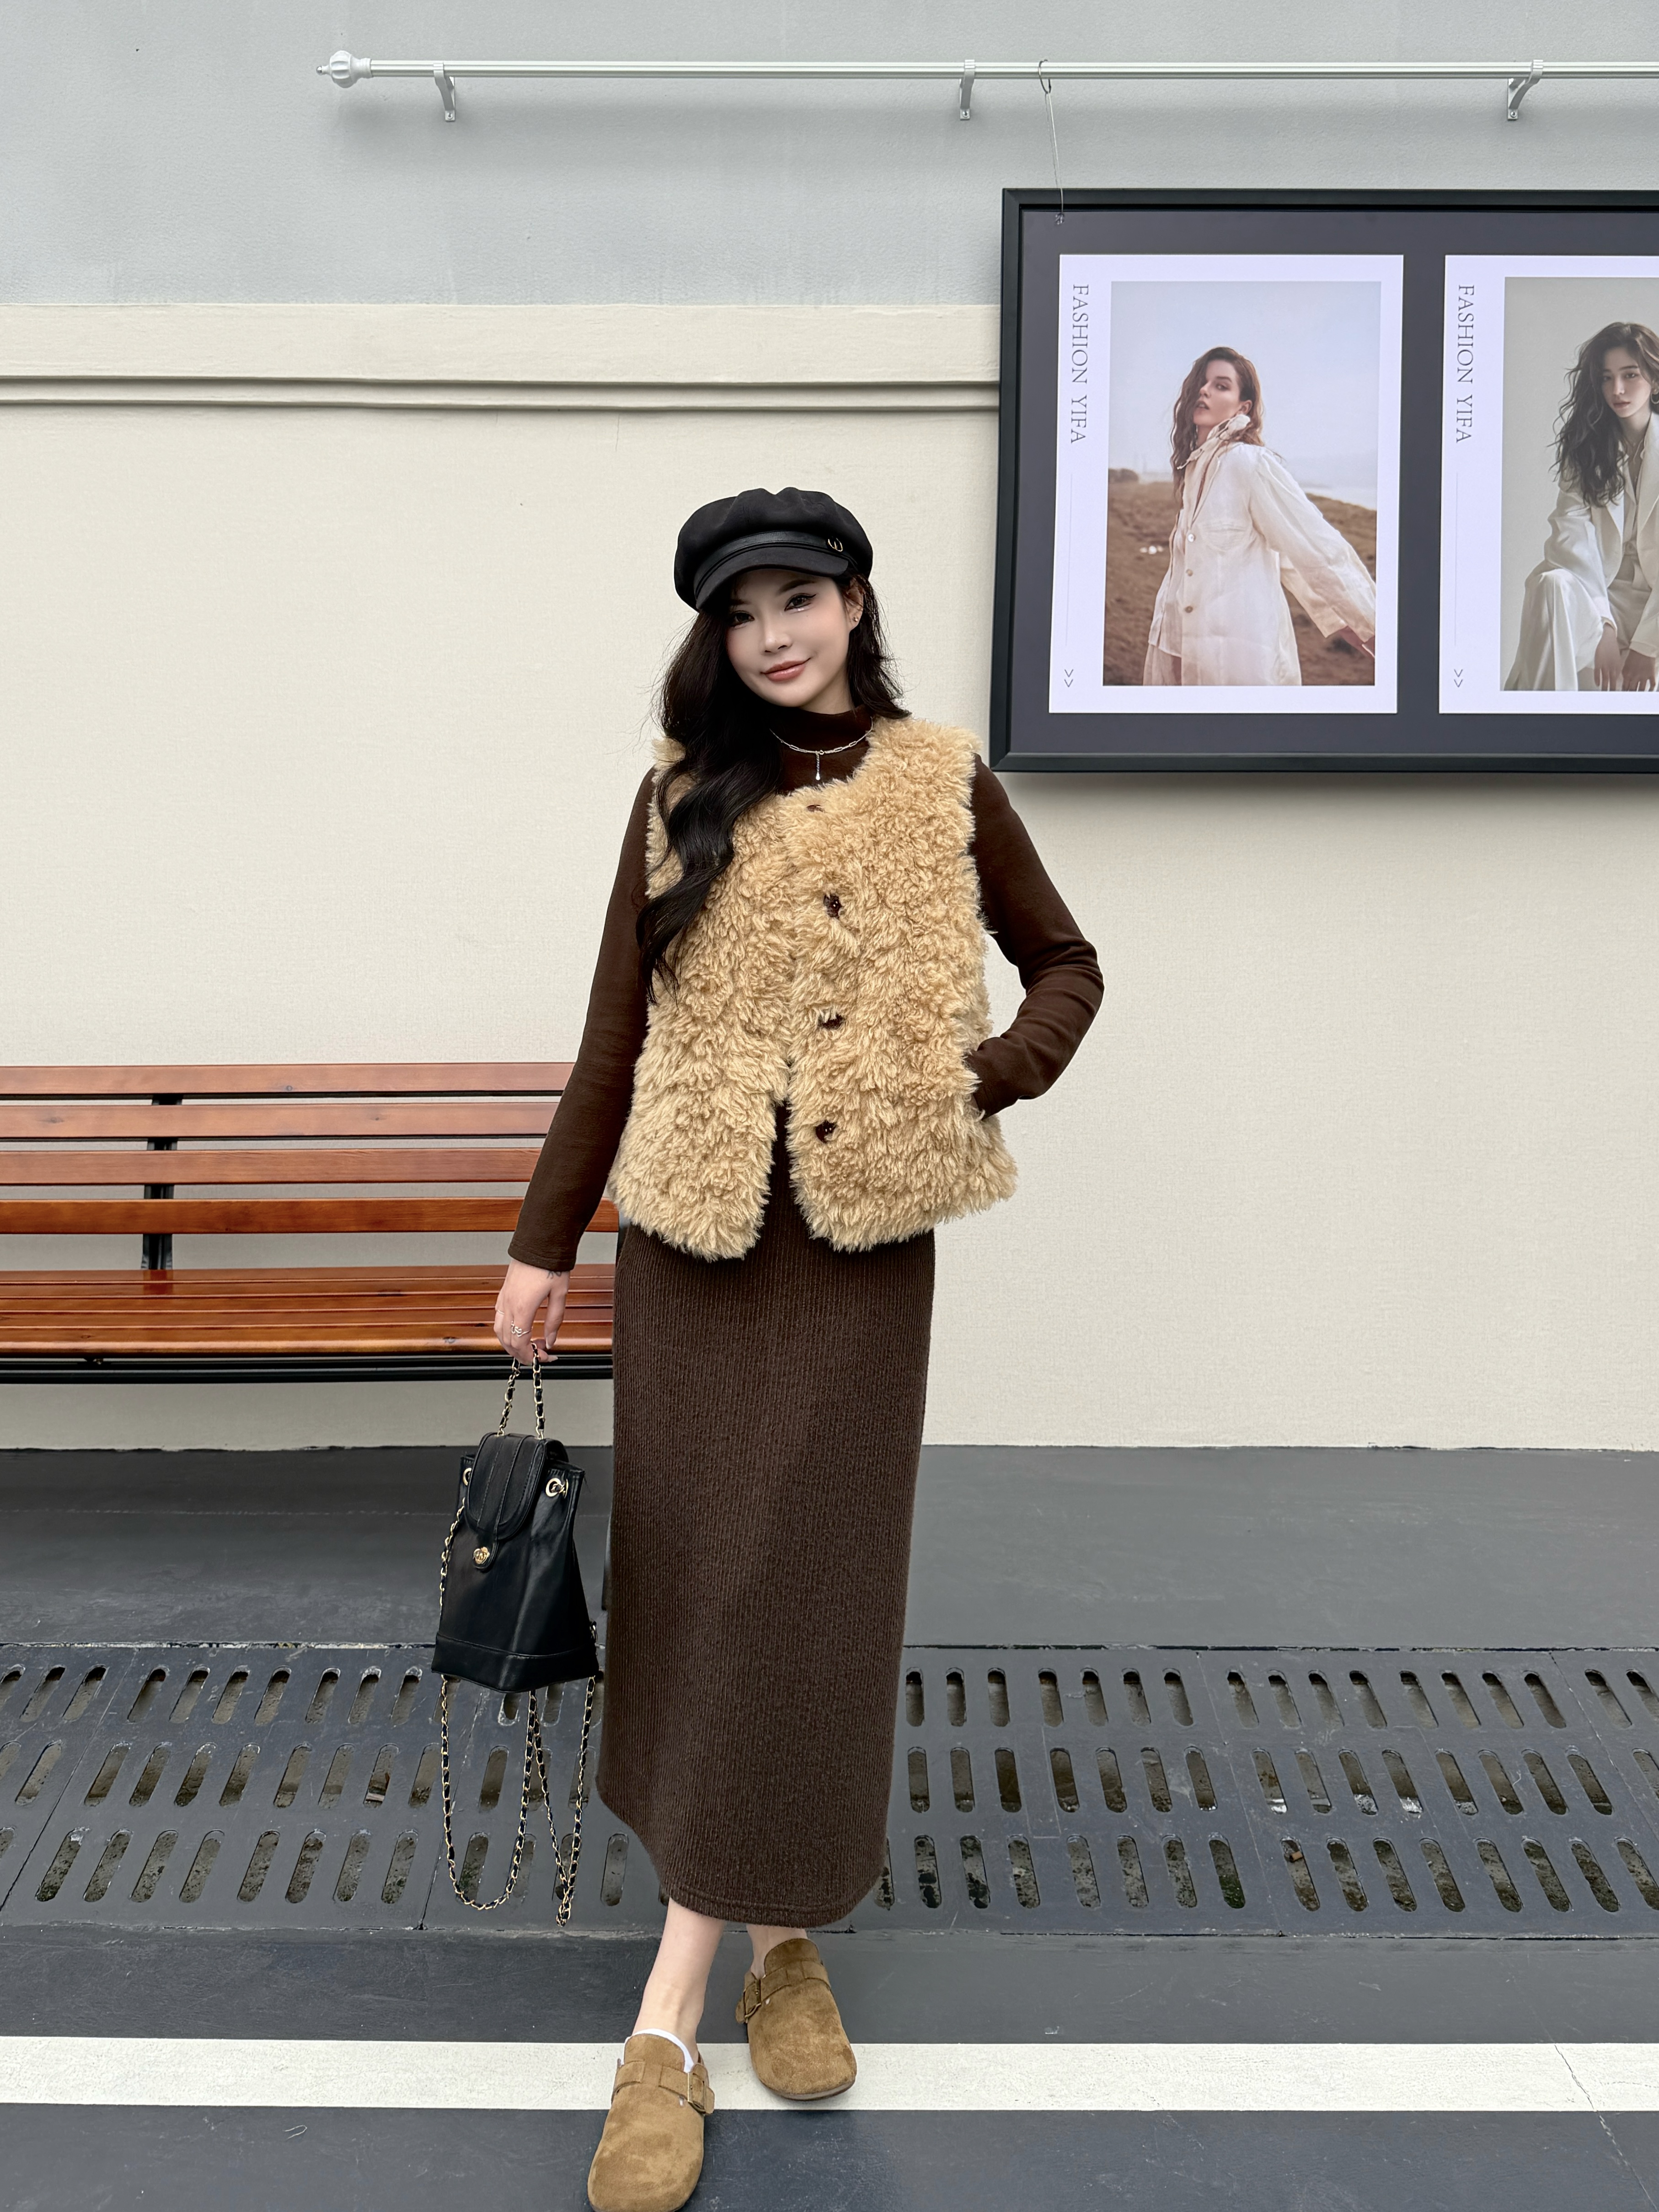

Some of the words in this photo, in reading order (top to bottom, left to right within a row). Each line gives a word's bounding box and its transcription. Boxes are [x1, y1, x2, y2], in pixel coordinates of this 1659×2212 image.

[1071, 284, 1089, 384] FASHION
[1457, 285, 1475, 384] FASHION
[1070, 394, 1087, 444] YIFA
[1456, 394, 1473, 443] YIFA
